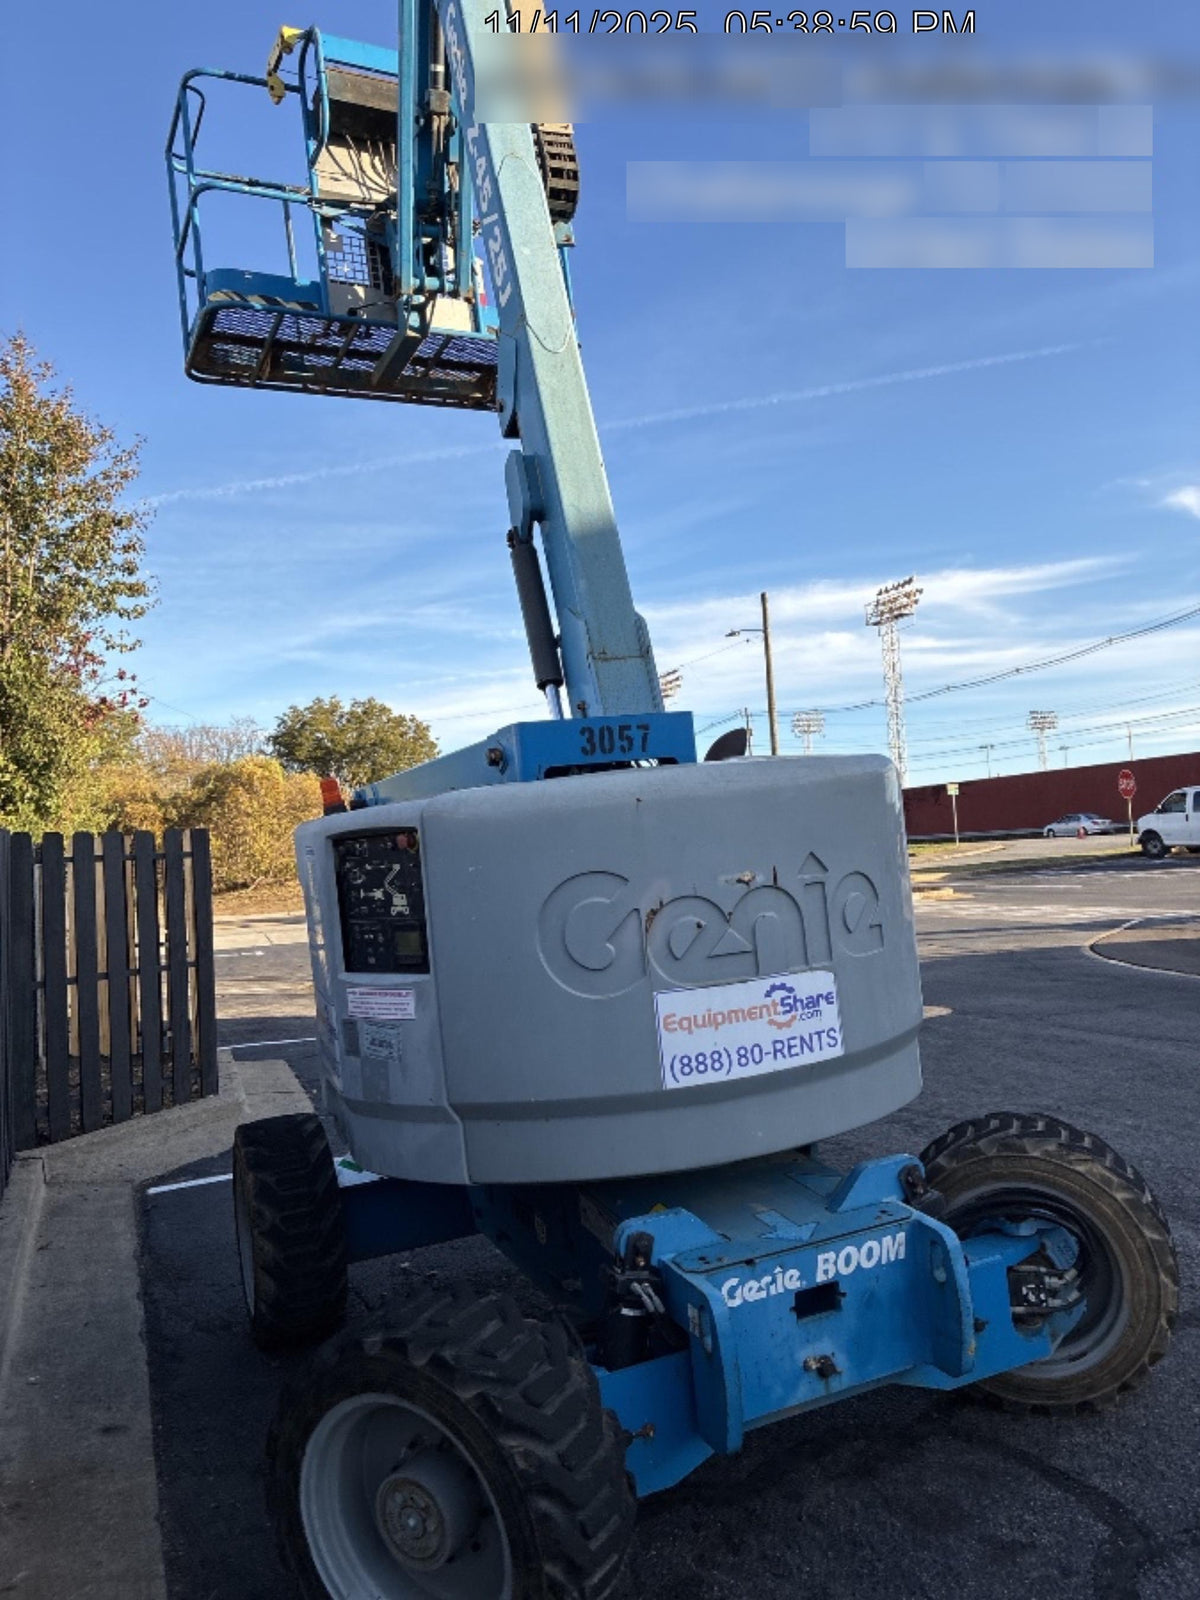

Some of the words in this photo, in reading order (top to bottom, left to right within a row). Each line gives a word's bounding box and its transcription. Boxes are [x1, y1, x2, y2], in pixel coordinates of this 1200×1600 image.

[579, 723, 651, 756] 3057
[537, 850, 885, 1000] Genie
[662, 991, 835, 1035] EquipmentShare
[799, 1008, 823, 1022] .com
[670, 1046, 733, 1084] (888)
[737, 1027, 839, 1068] 80-RENTS
[721, 1265, 801, 1308] Genie
[815, 1231, 906, 1283] BOOM
